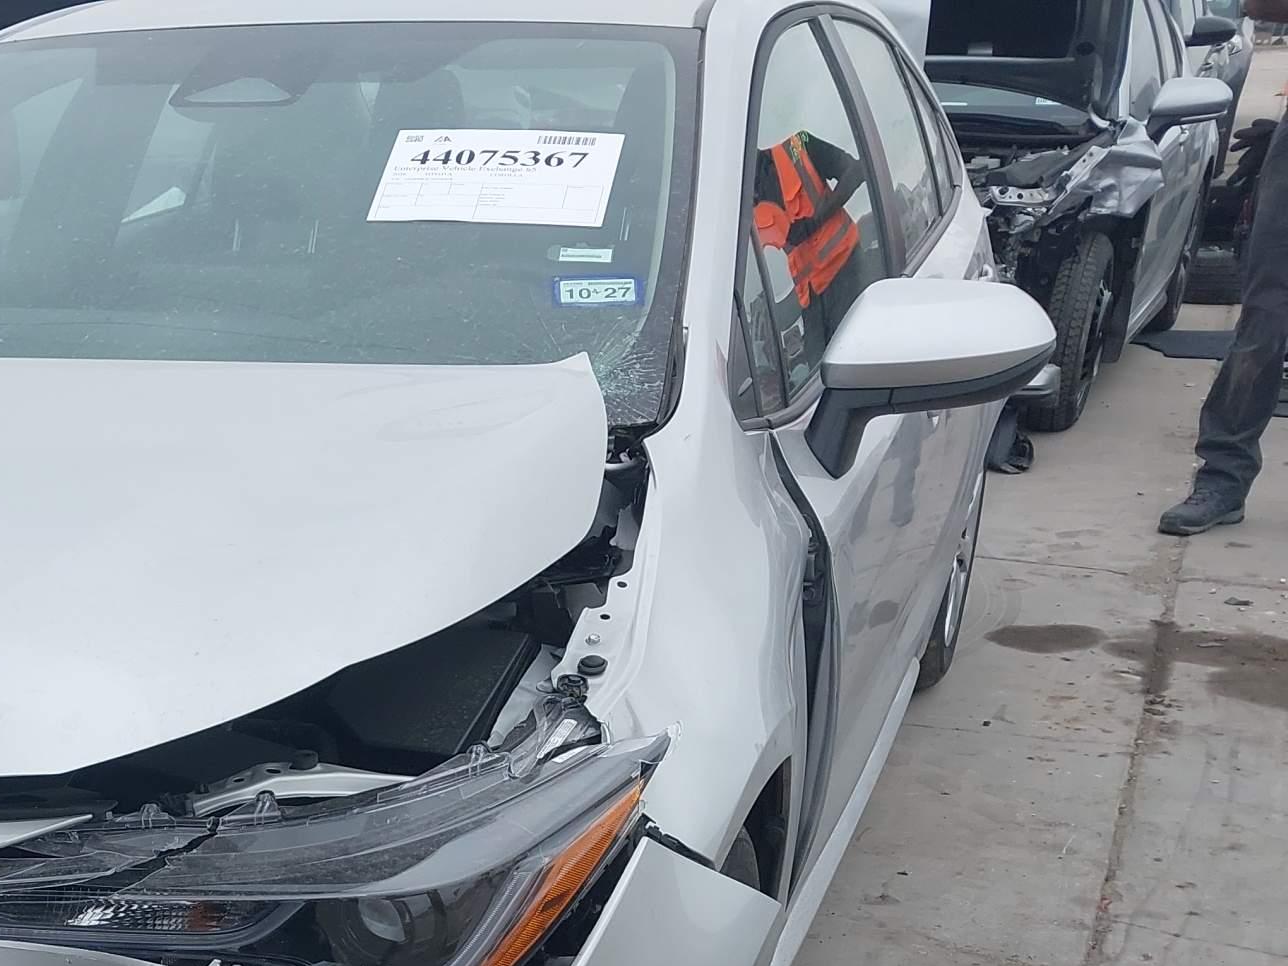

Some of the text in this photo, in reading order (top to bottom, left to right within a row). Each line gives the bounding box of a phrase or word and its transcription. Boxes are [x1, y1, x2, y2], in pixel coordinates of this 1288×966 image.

[410, 149, 590, 168] 44075367
[564, 287, 631, 299] 10 27
